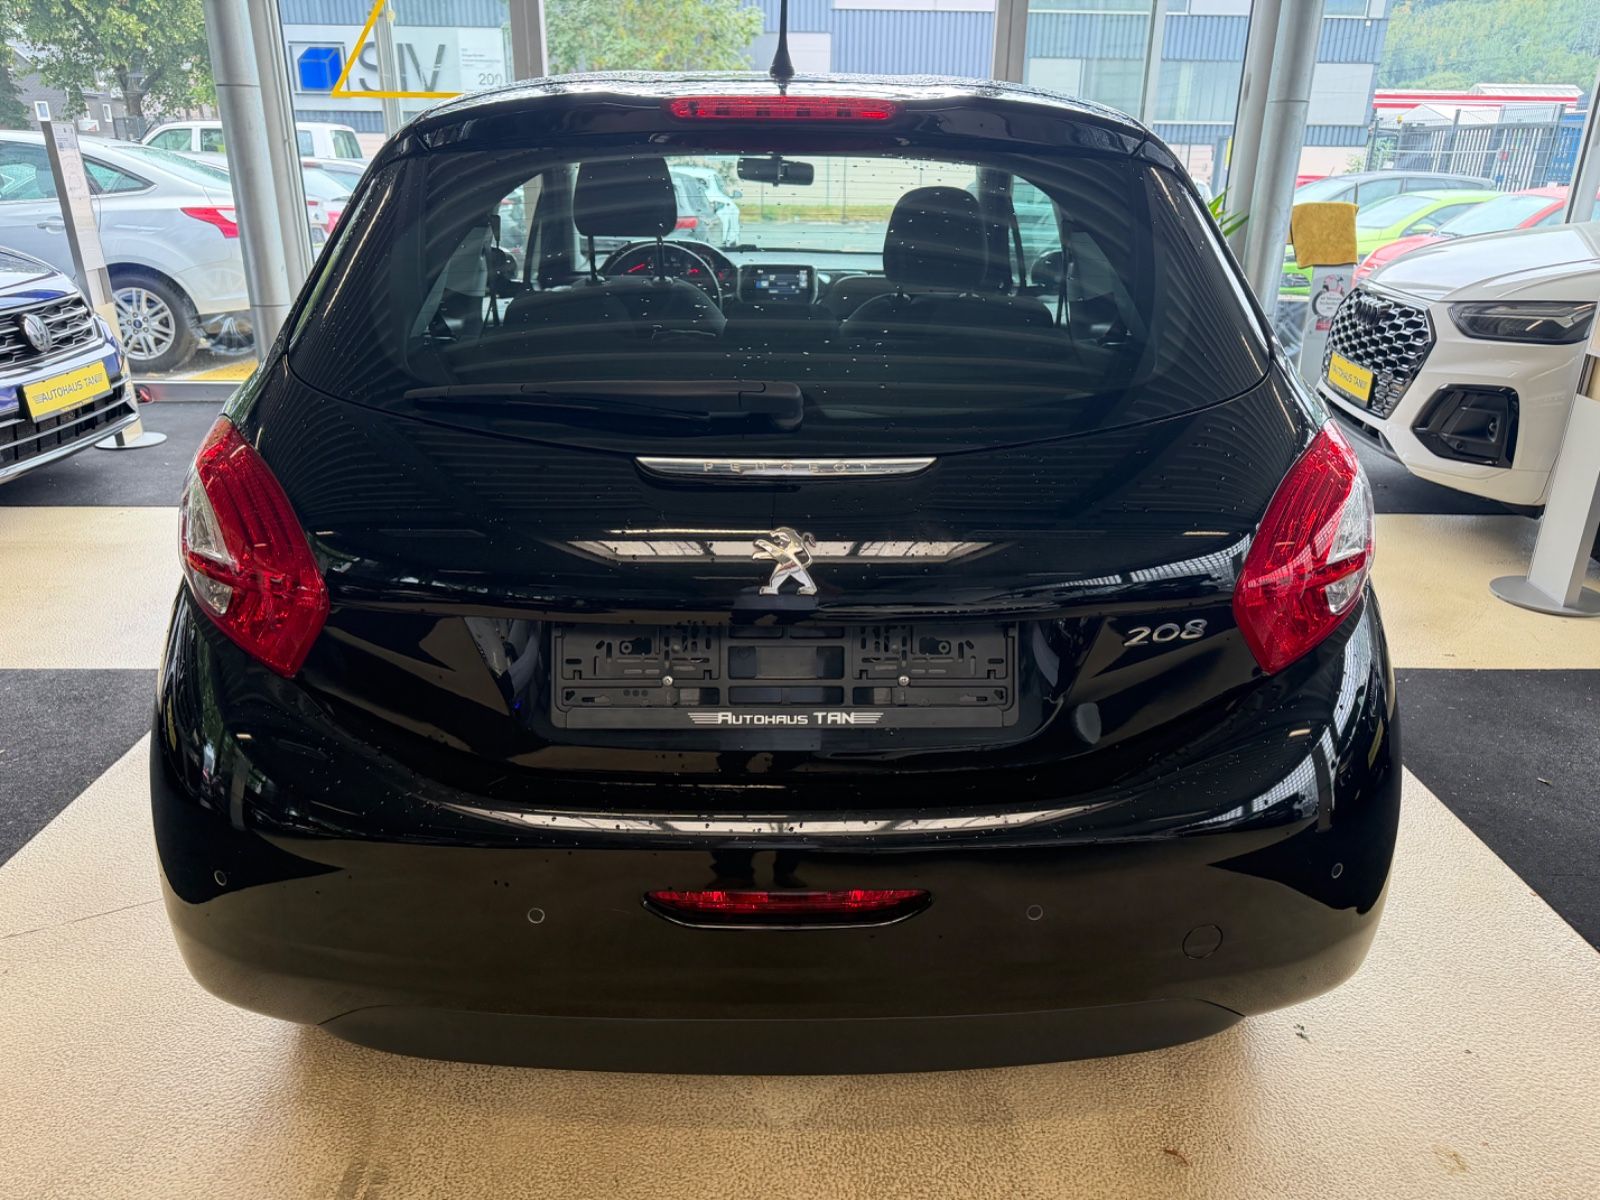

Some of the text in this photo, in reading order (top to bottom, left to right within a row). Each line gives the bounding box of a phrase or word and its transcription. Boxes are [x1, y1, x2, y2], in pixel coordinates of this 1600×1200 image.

[42, 375, 98, 403] AUTOHAUS TAN
[703, 462, 872, 474] PEUGEOT
[1124, 619, 1207, 646] 208
[813, 711, 855, 725] TAN
